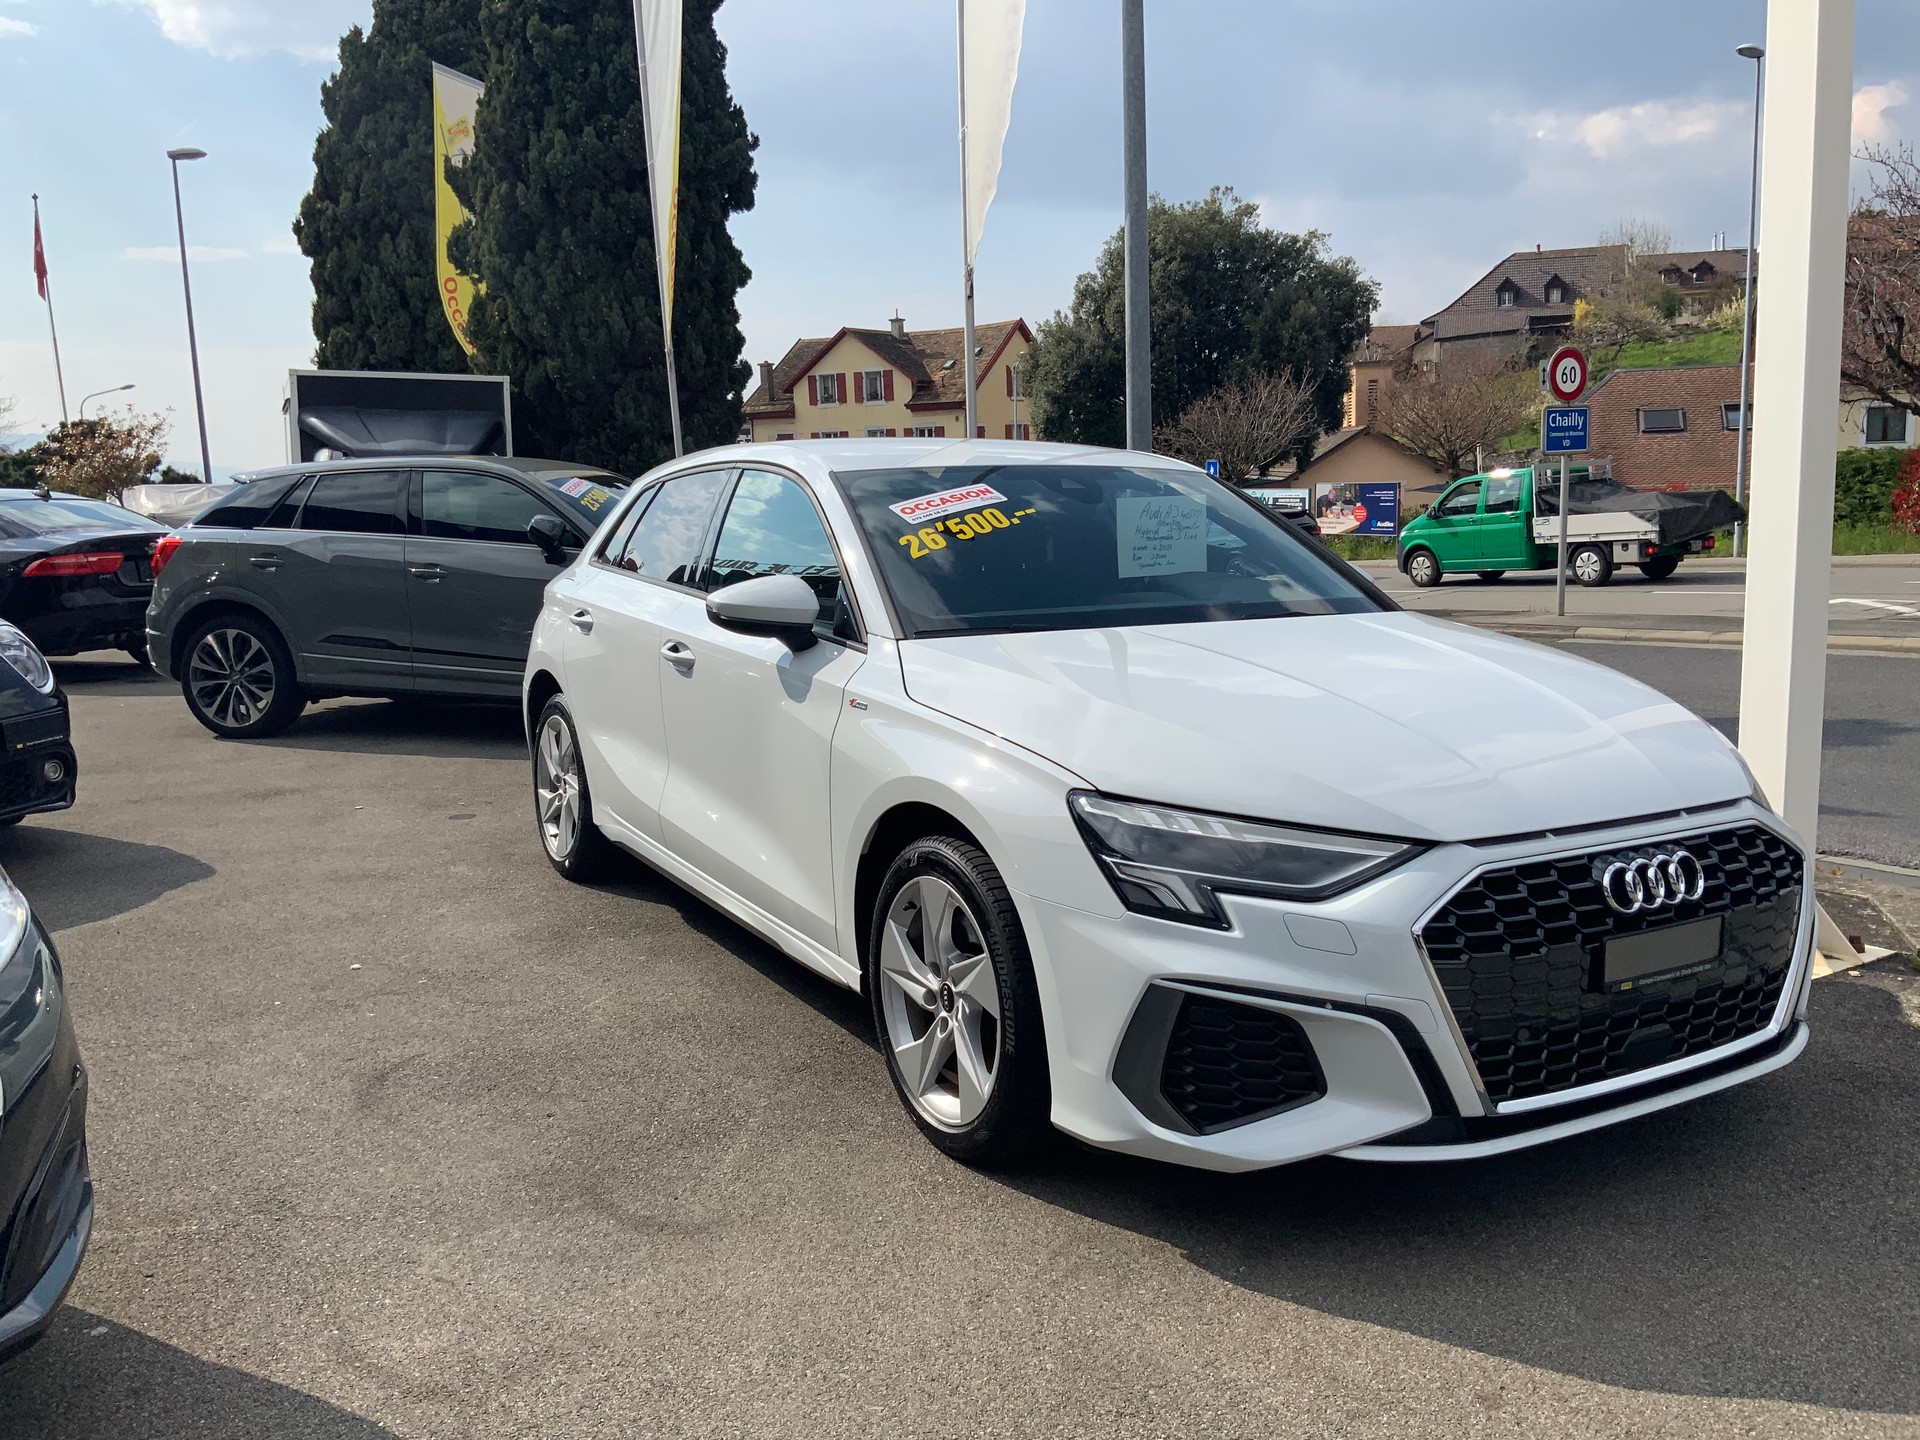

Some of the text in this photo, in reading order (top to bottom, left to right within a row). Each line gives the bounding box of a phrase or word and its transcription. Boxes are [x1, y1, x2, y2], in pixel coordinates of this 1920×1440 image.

[1561, 366, 1577, 384] 60
[1549, 411, 1584, 430] Chailly
[1562, 439, 1571, 447] VD
[900, 487, 994, 516] OCCASION
[1140, 502, 1163, 520] Audi
[1163, 503, 1180, 520] A3
[898, 508, 1037, 559] 26'500.--
